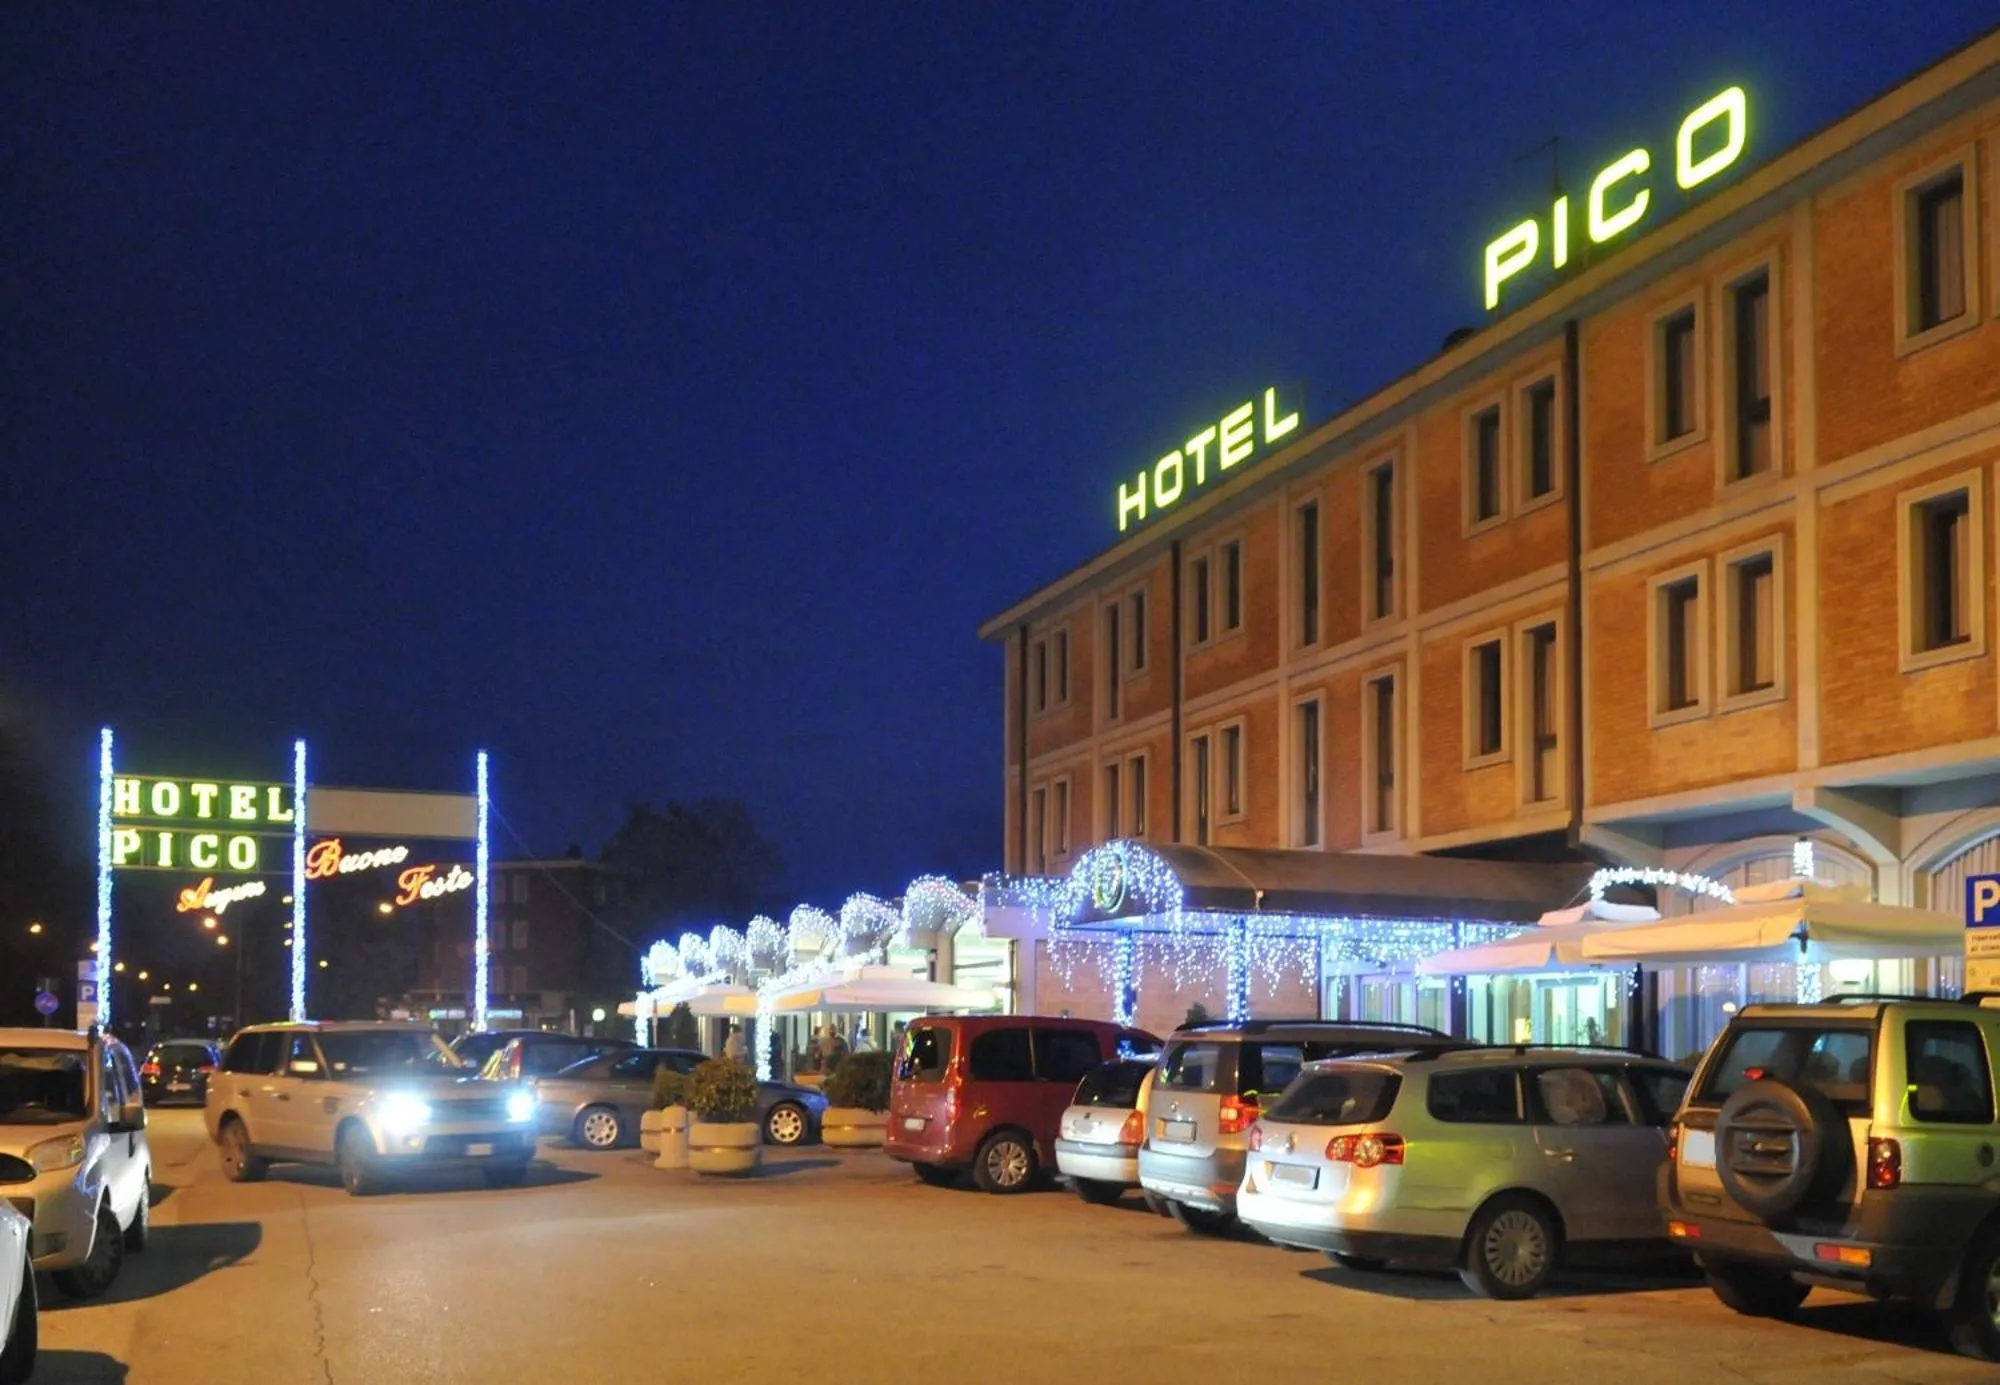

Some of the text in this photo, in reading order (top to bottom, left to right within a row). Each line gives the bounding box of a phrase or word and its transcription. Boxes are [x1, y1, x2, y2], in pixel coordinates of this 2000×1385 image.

[1118, 86, 1746, 533] HOTEL PICO
[114, 779, 294, 822] HOTEL
[112, 828, 257, 870] PICO
[1974, 880, 2000, 922] P
[81, 984, 96, 1001] P
